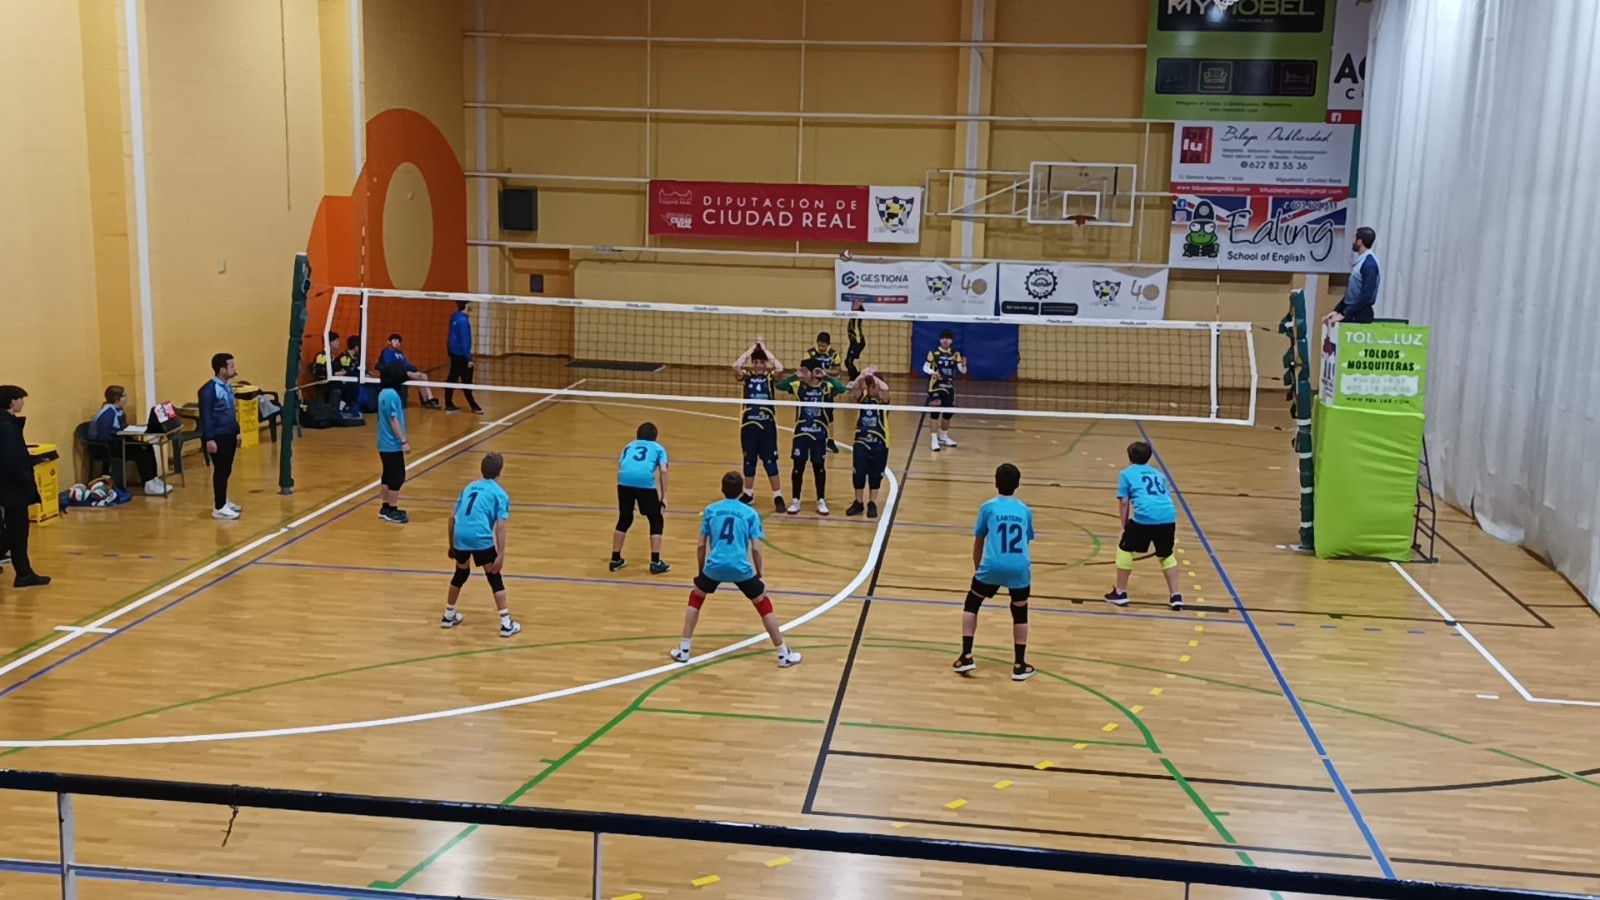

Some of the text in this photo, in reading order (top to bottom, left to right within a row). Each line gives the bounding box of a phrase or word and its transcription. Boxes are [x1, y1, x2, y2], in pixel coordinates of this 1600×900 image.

[1248, 161, 1308, 171] 622 82 55 36
[836, 200, 858, 210] DE
[702, 209, 857, 229] CIUDAD REAL
[1225, 208, 1334, 262] Ealing
[1227, 251, 1306, 264] School of English
[860, 274, 909, 283] GESTIONA
[1363, 348, 1400, 359] TOLDOS
[1347, 360, 1415, 372] MOSQUITERAS
[632, 445, 649, 462] 3
[1141, 475, 1167, 496] 26
[465, 491, 478, 516] 1
[719, 517, 735, 545] 4
[997, 522, 1023, 554] 12
